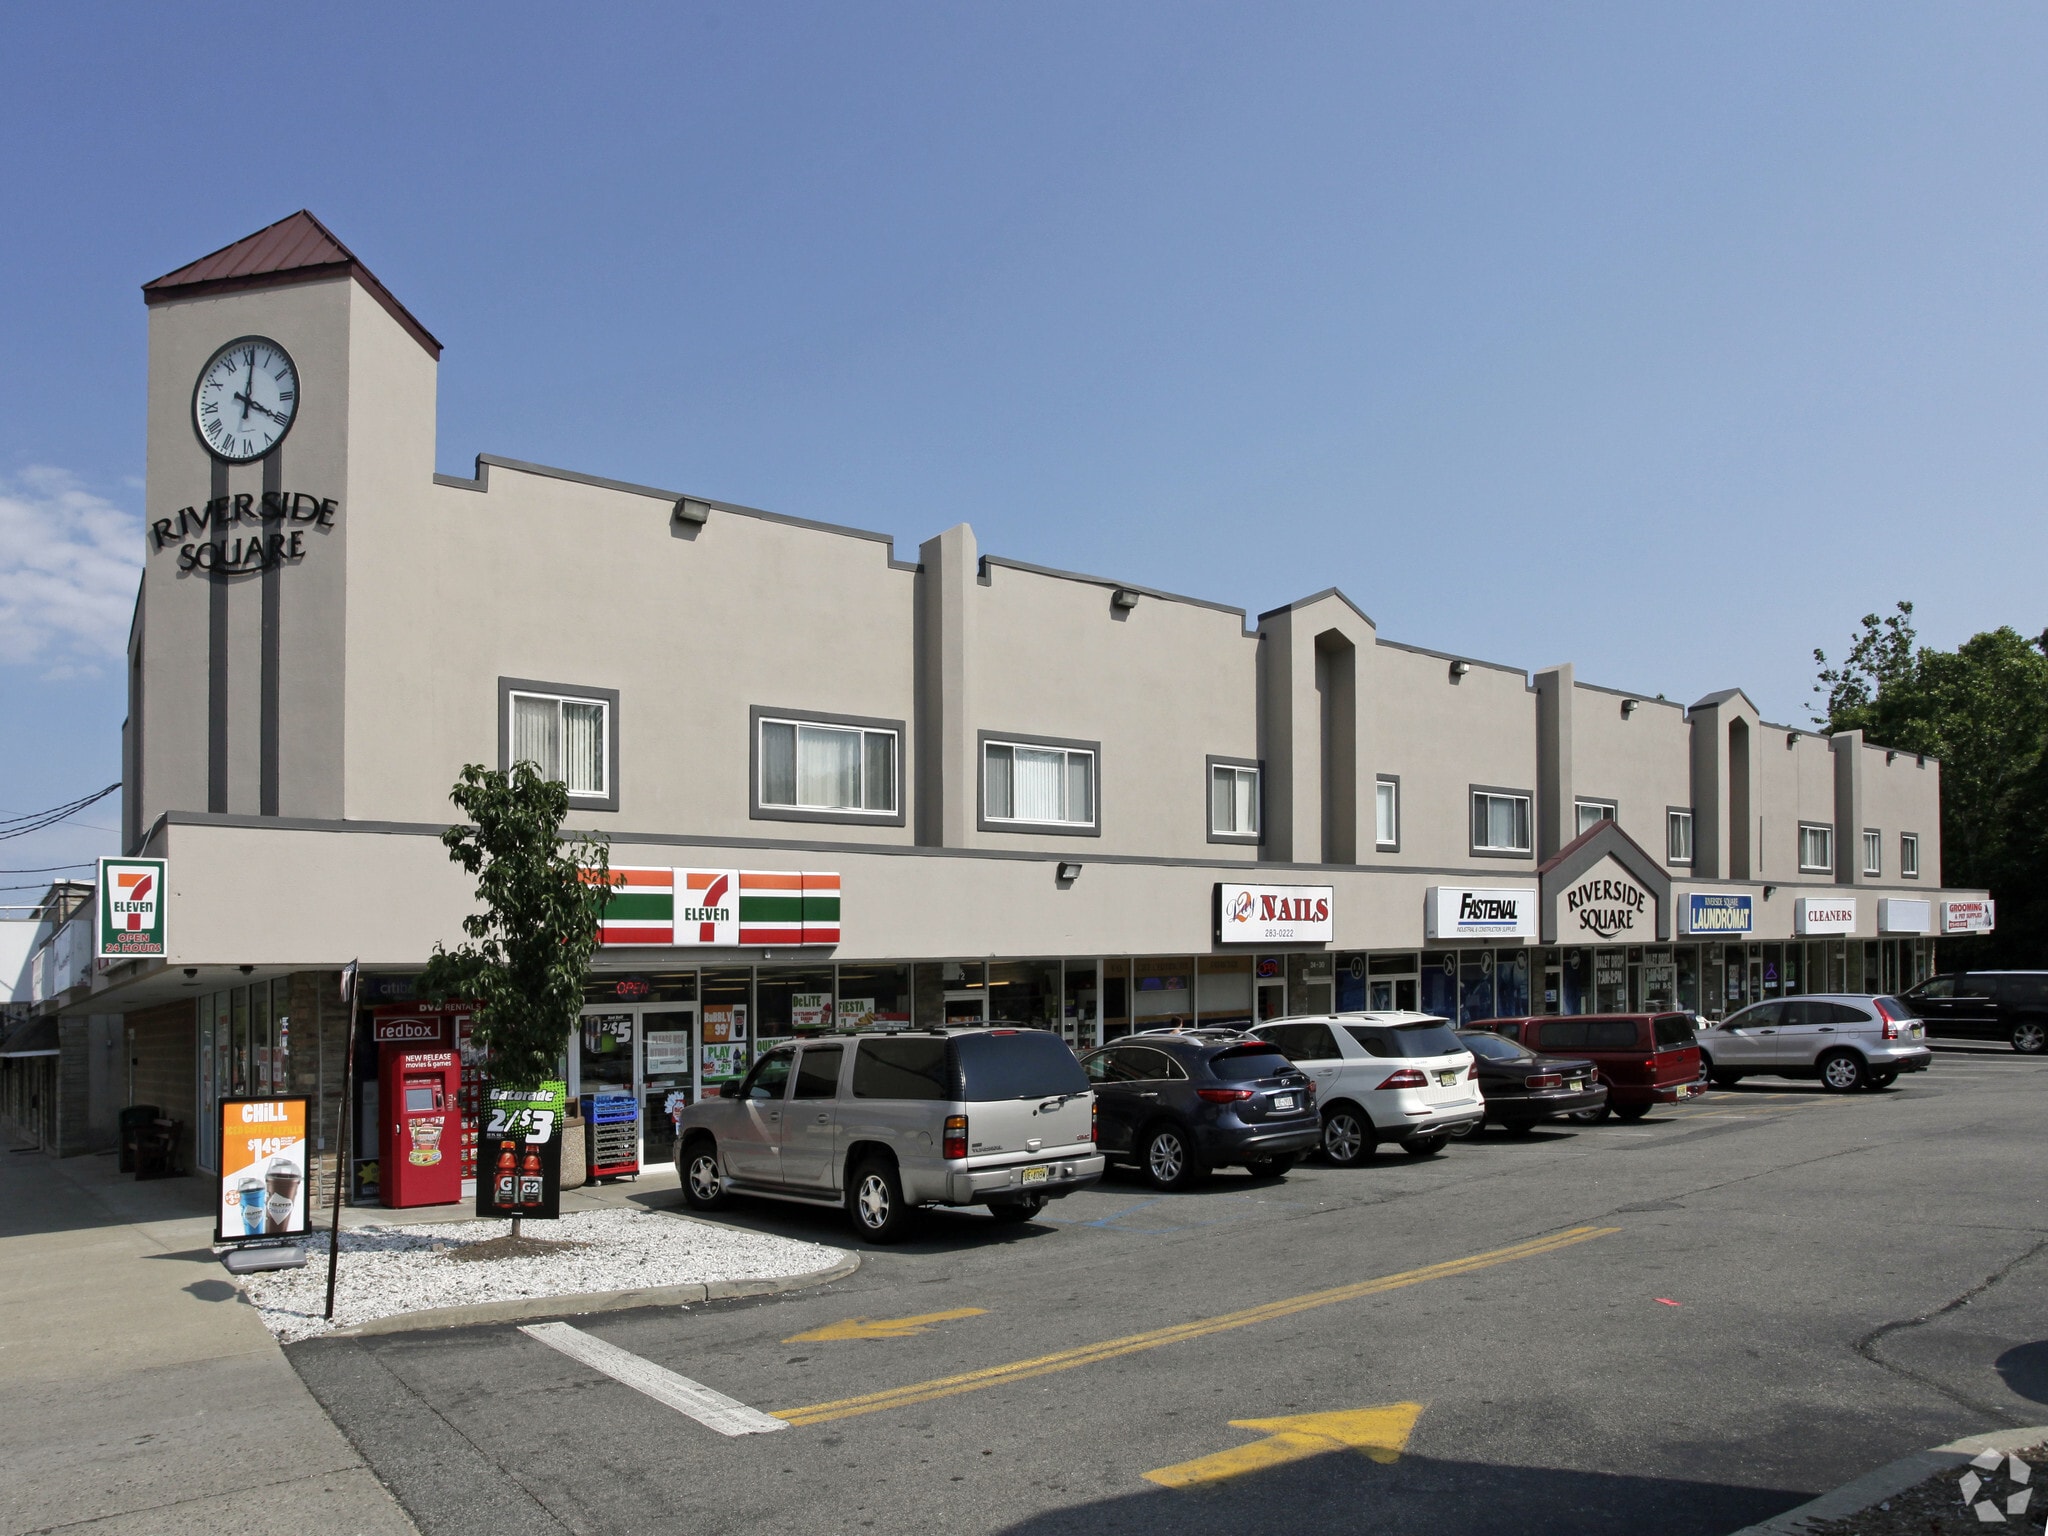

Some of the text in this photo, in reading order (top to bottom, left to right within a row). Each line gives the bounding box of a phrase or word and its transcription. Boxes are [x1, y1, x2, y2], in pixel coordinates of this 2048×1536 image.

[152, 492, 339, 549] RIVERSIDE
[179, 530, 306, 575] SQUARE
[118, 873, 152, 931] 7
[1567, 879, 1645, 914] RIVERSIDE
[686, 873, 729, 942] 7
[1259, 895, 1329, 922] NAILS
[1459, 893, 1518, 919] FASTENAL
[1949, 903, 1982, 912] GROOMING
[1692, 907, 1750, 929] LAUNDROMAT
[1808, 910, 1852, 922] CLEANERS
[1579, 908, 1634, 939] SQUARE
[118, 933, 150, 942] OPEN
[1265, 929, 1294, 938] 283-0222
[106, 943, 161, 953] 24 HOURS
[380, 983, 412, 994] citib
[617, 981, 649, 994] OPEN
[445, 1003, 481, 1011] RENTALS
[380, 1024, 432, 1038] redbox
[602, 1021, 632, 1043] 2/$5
[405, 1053, 452, 1063] NEW RELEASE
[707, 1045, 731, 1058] PLAY
[432, 1060, 452, 1069] games
[490, 1088, 555, 1102] Gatorade
[241, 1102, 288, 1123] CHiLL
[487, 1108, 555, 1144] 2/$3
[500, 1177, 512, 1190] G
[522, 1182, 539, 1193] G2
